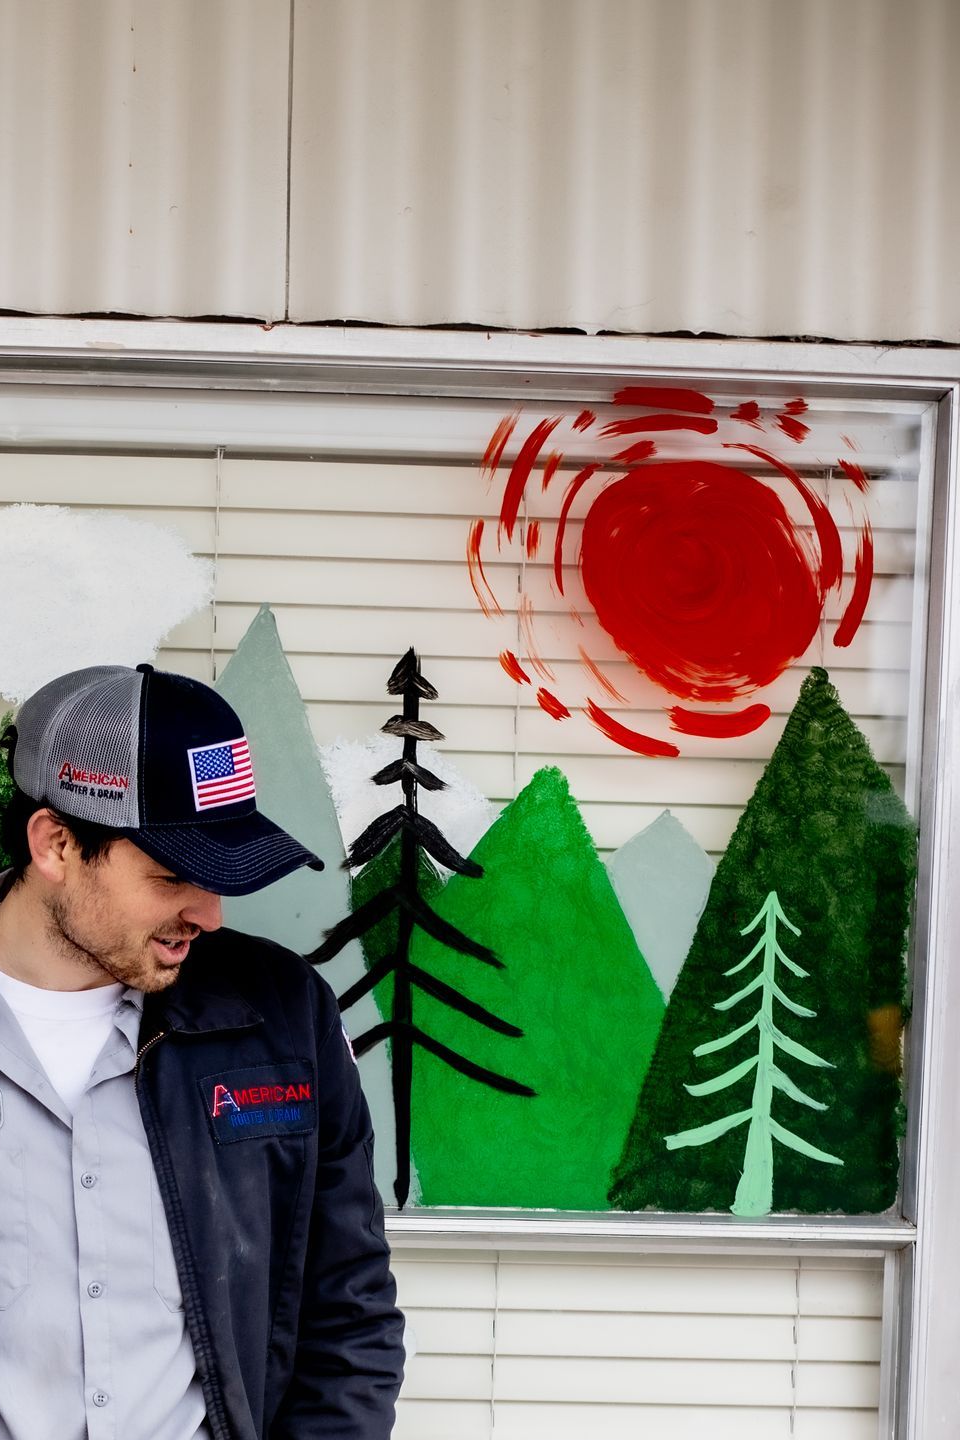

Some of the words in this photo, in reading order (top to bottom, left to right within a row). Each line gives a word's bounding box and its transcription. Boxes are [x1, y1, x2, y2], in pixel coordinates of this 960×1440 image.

[58, 762, 128, 788] AMERICAN
[60, 780, 88, 795] ROOTER
[90, 787, 95, 797] &
[98, 789, 123, 801] DRAIN
[212, 1083, 311, 1117] AMERICAN
